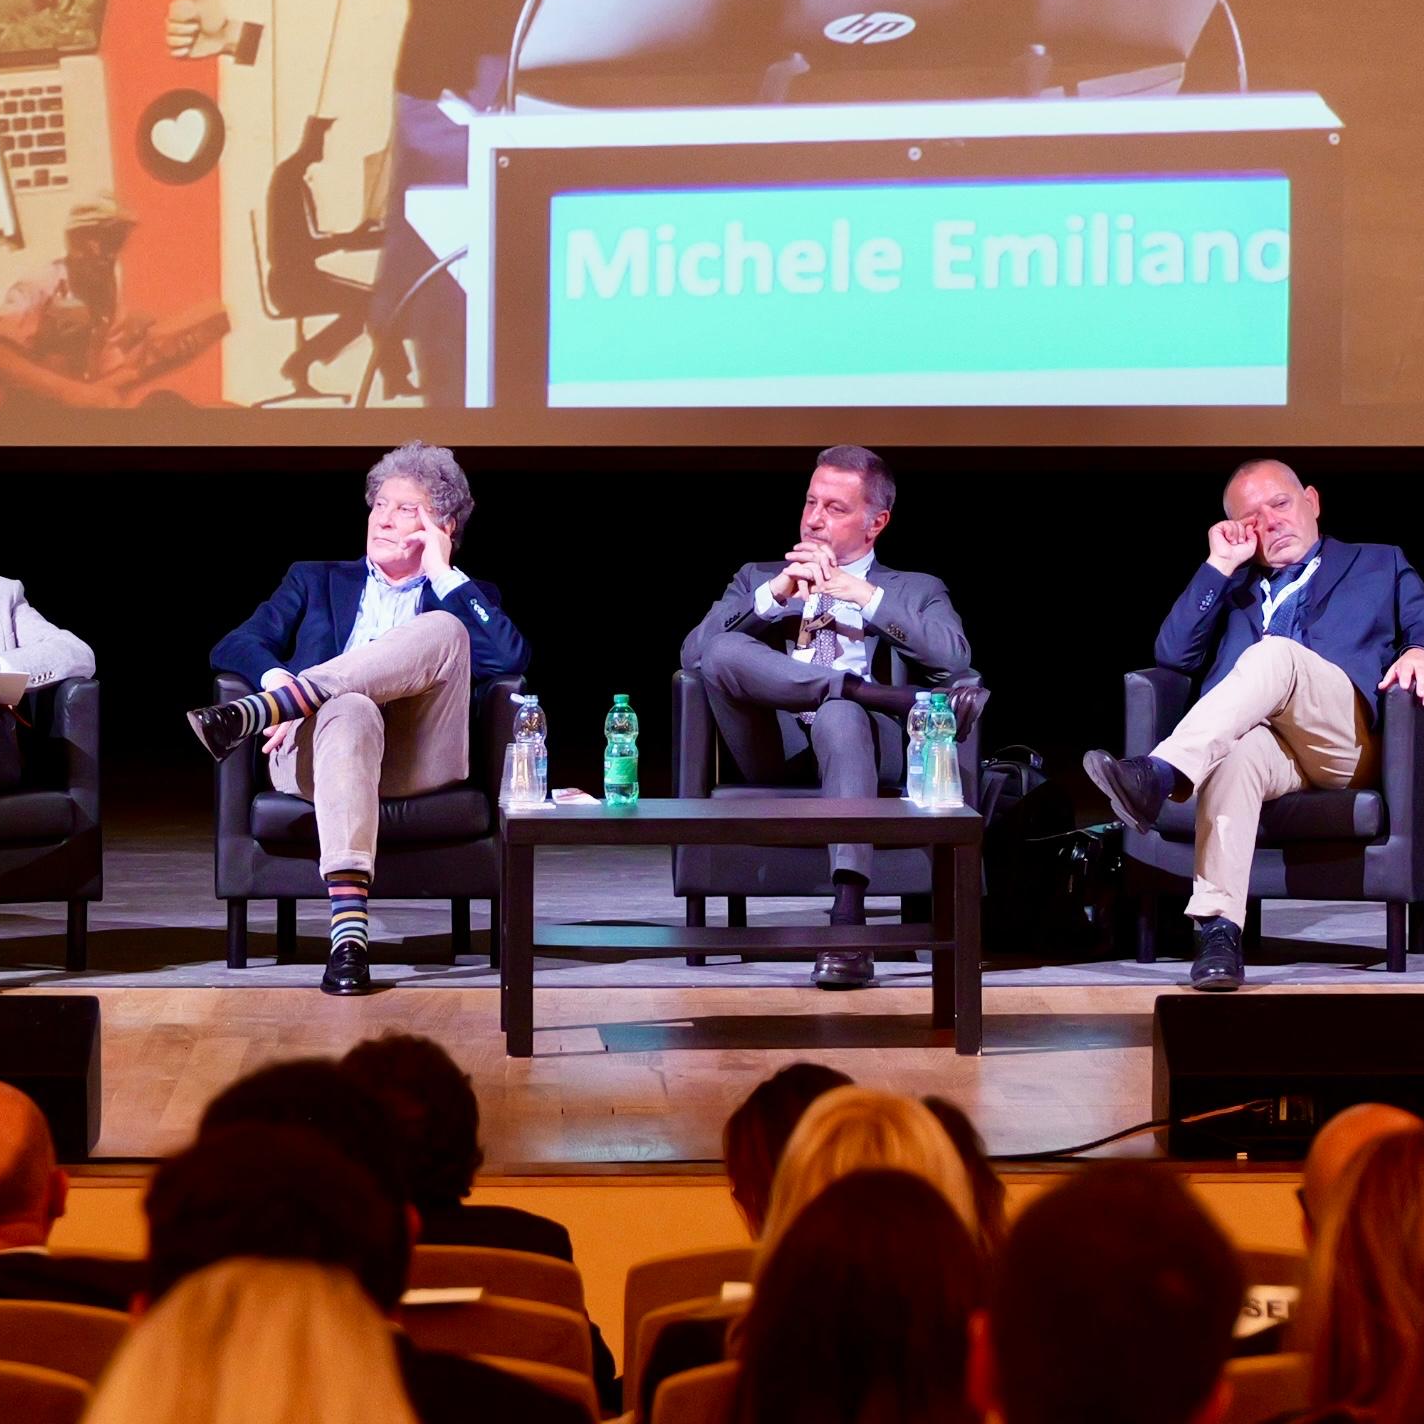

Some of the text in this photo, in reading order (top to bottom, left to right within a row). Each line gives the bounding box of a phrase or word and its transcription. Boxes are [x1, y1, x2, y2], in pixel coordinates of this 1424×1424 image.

[828, 11, 912, 45] hp
[566, 212, 1290, 299] Michele Emiliano
